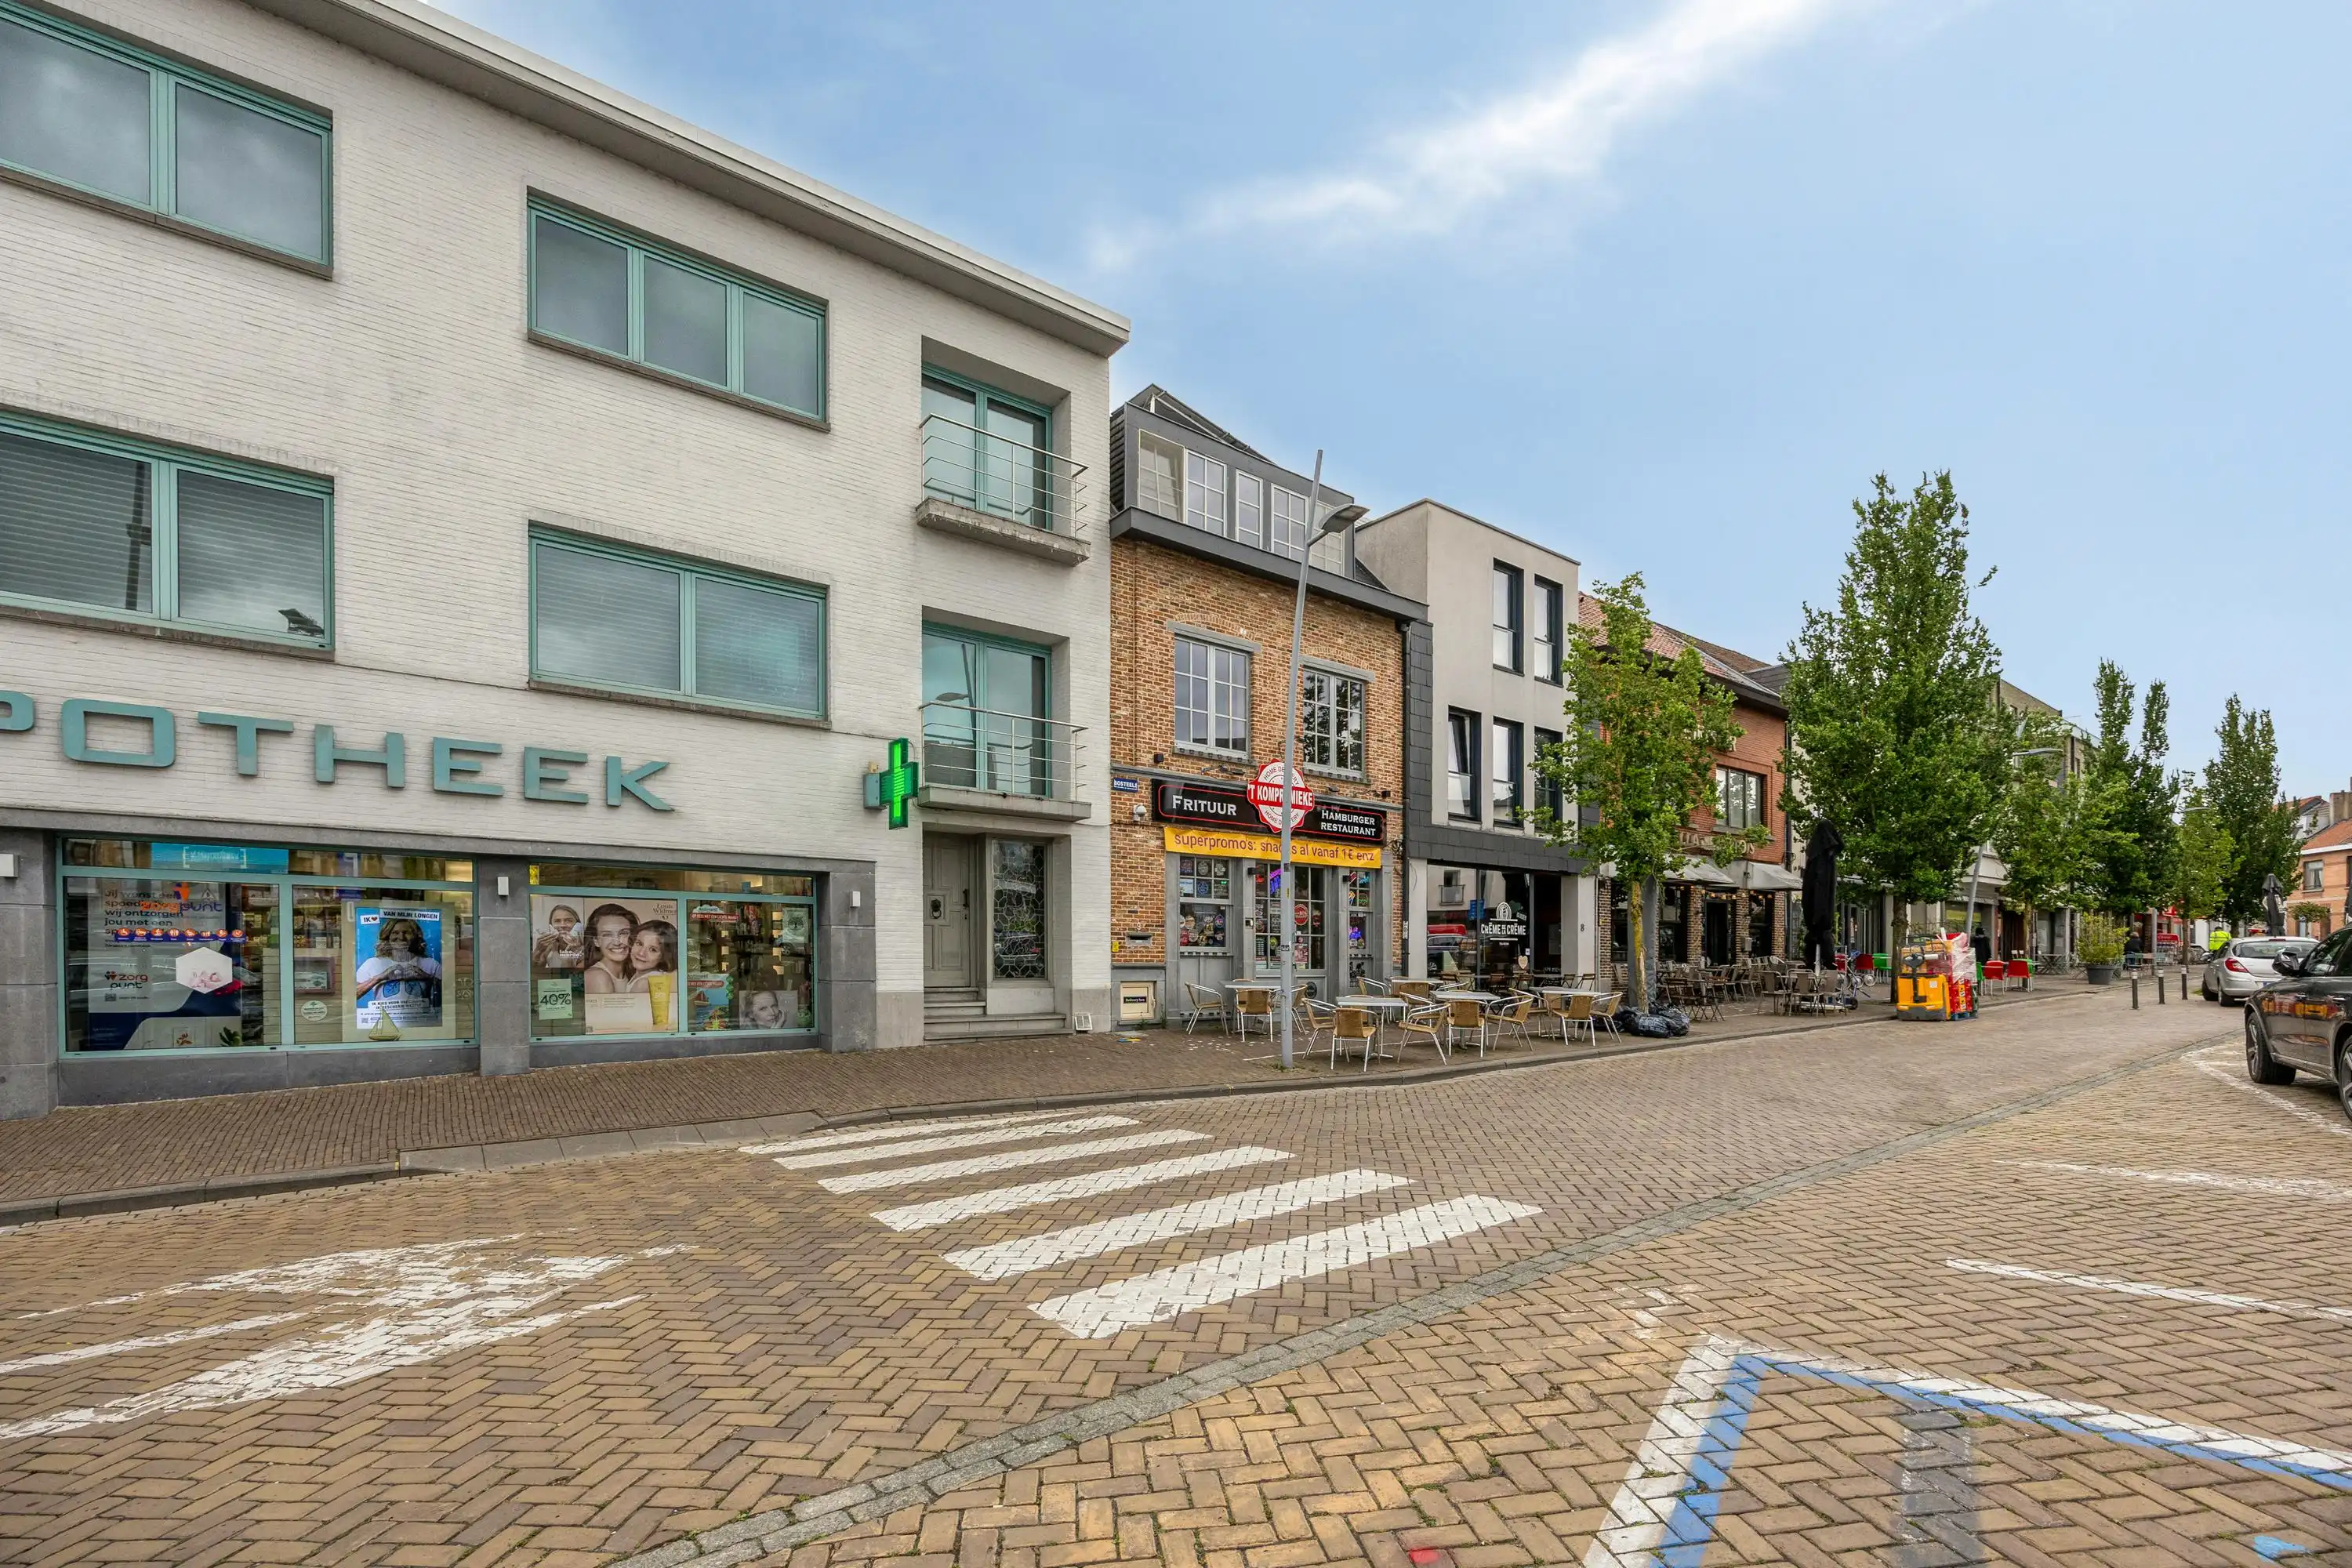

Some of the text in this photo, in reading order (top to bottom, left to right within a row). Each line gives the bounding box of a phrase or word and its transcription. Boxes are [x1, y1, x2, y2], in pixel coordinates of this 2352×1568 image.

[1264, 766, 1299, 785] HOME DEERY
[1257, 785, 1313, 807] KOMPRMIEKE
[1265, 811, 1299, 826] HOME DERY
[1321, 809, 1375, 826] HAMBURGER
[1320, 822, 1376, 837] RESTAURANT
[1260, 841, 1297, 855] snacs
[1300, 843, 1309, 855] al
[1312, 847, 1339, 858] vanaf
[1356, 851, 1374, 862] enz
[1580, 924, 1584, 932] 8
[540, 992, 572, 1006] 40%
